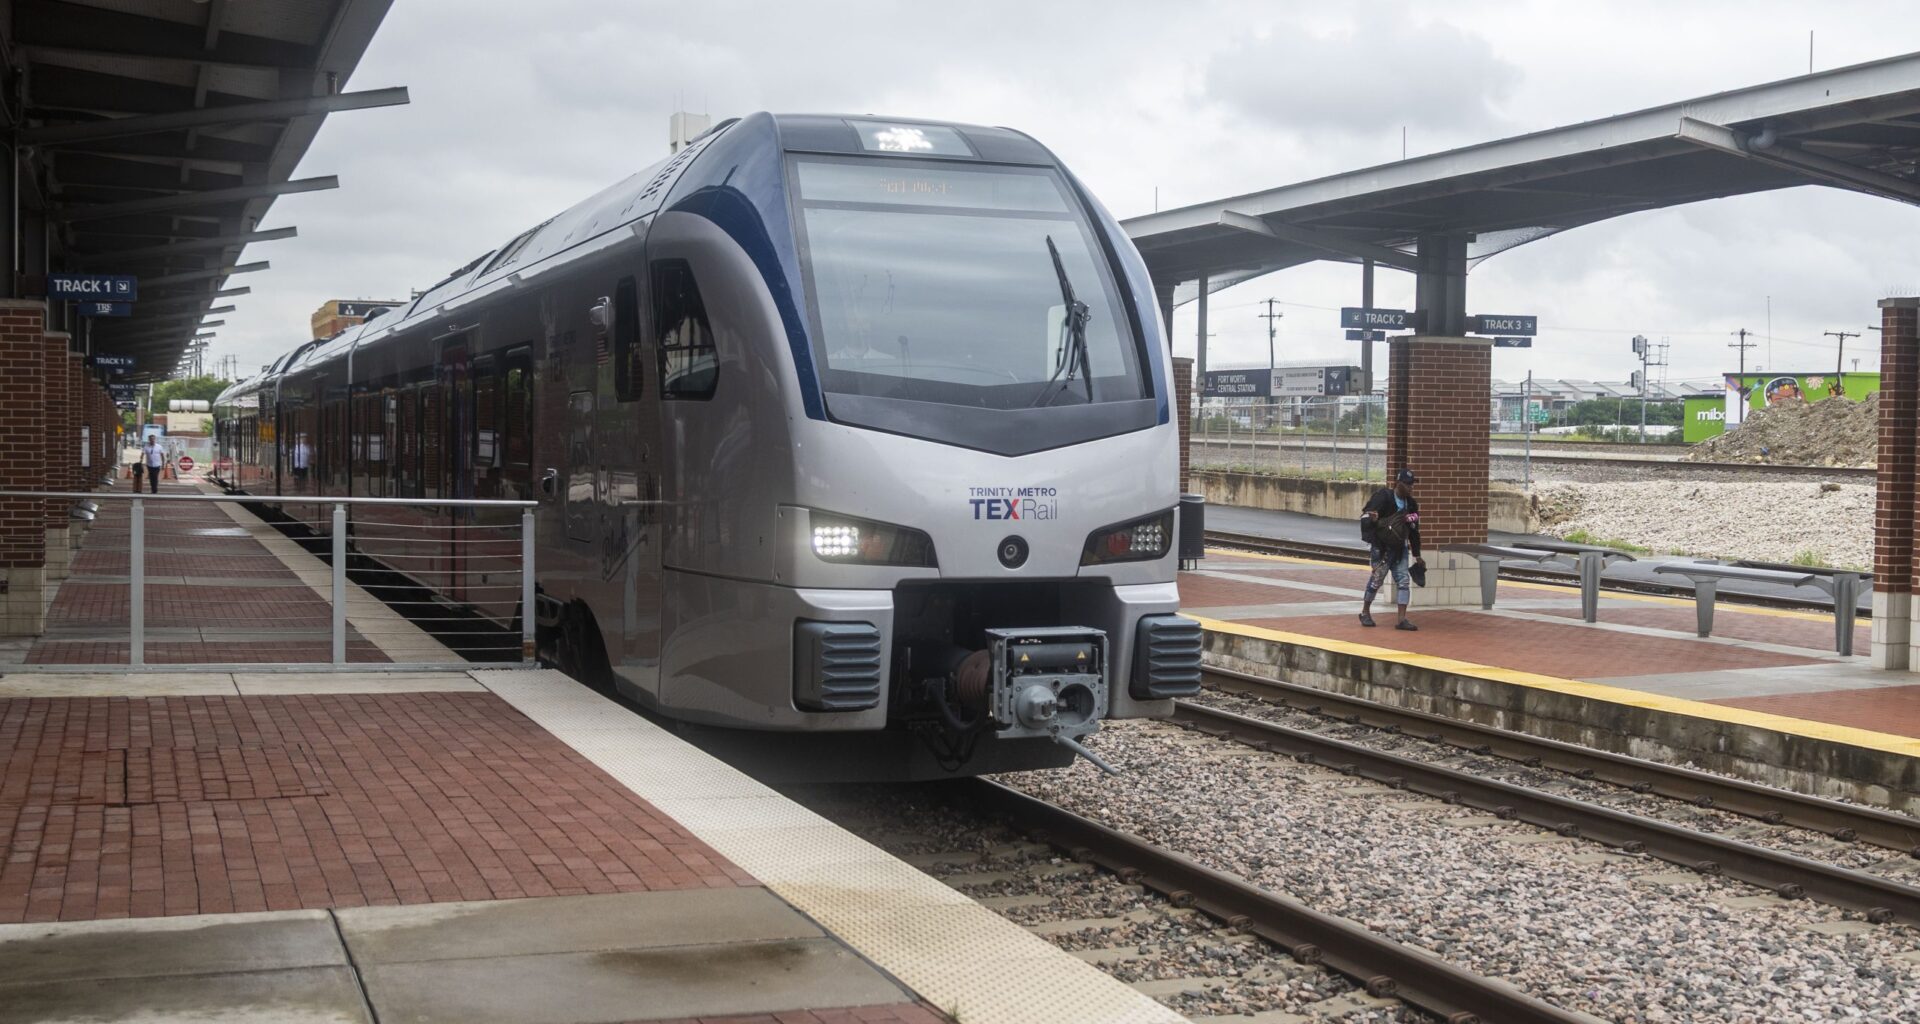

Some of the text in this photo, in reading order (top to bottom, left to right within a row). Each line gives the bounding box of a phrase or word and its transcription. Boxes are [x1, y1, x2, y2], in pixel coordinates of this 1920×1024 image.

[54, 279, 111, 293] TRACK 1
[1365, 312, 1404, 325] TRACK 2
[1485, 319, 1522, 331] TRACK 3
[96, 357, 119, 365] TRACK
[1217, 374, 1246, 384] FORT WORTH
[1217, 384, 1237, 393] CENTRAL
[1237, 383, 1256, 393] STATION
[969, 487, 1057, 497] TRINITY METRO
